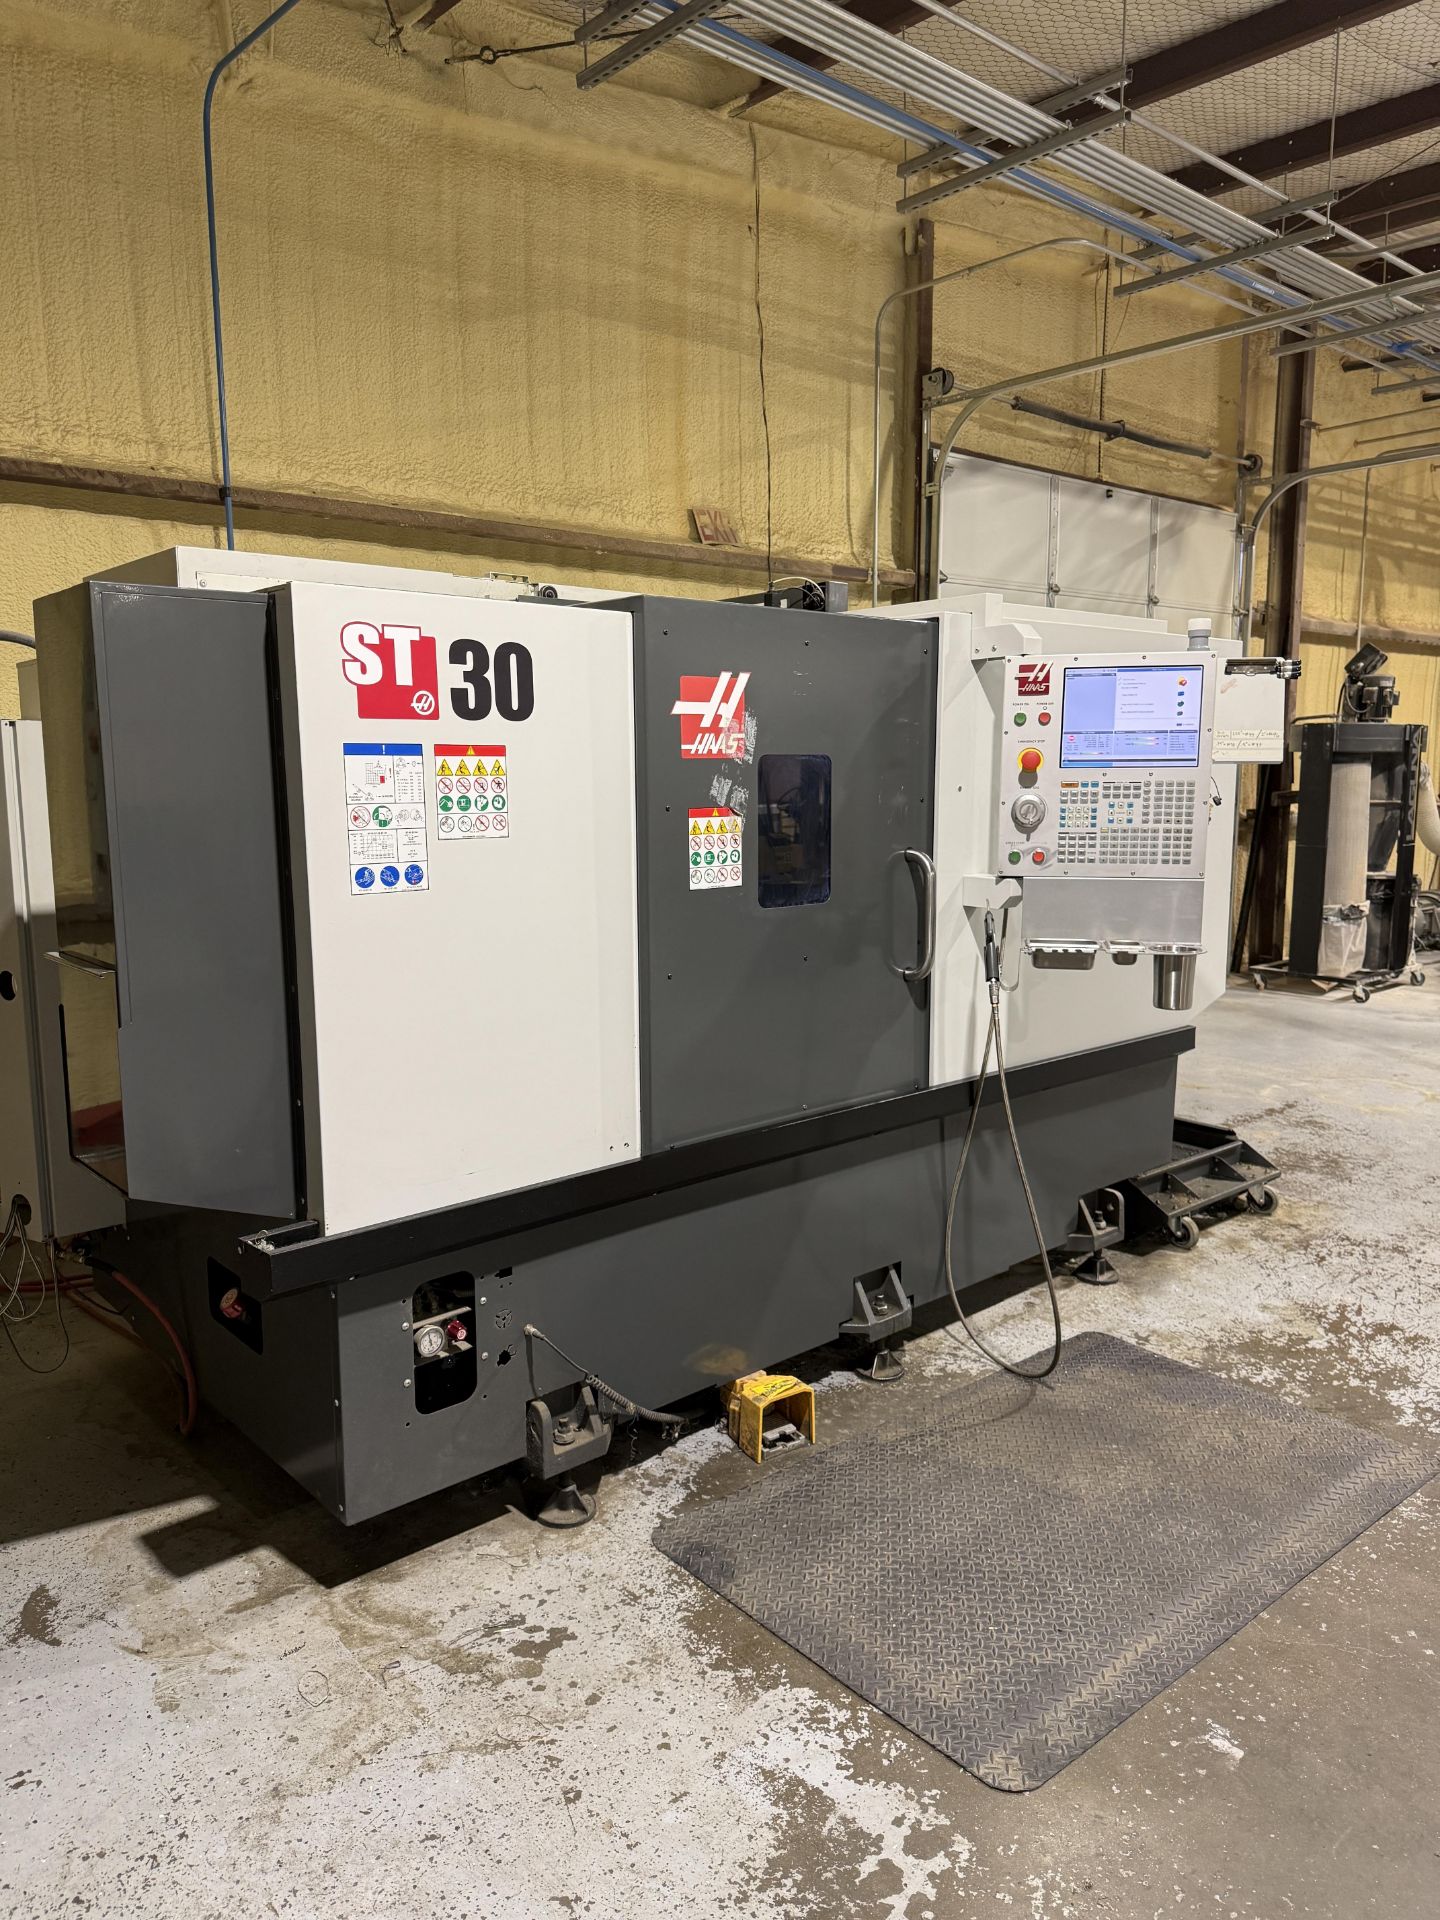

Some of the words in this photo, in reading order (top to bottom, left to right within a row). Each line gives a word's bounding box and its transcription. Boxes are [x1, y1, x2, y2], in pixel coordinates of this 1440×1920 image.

[340, 621, 421, 687] ST
[448, 638, 535, 722] 30
[1018, 683, 1050, 692] HAAS
[681, 733, 745, 754] HAAS
[1406, 727, 1422, 841] LAGUNA
